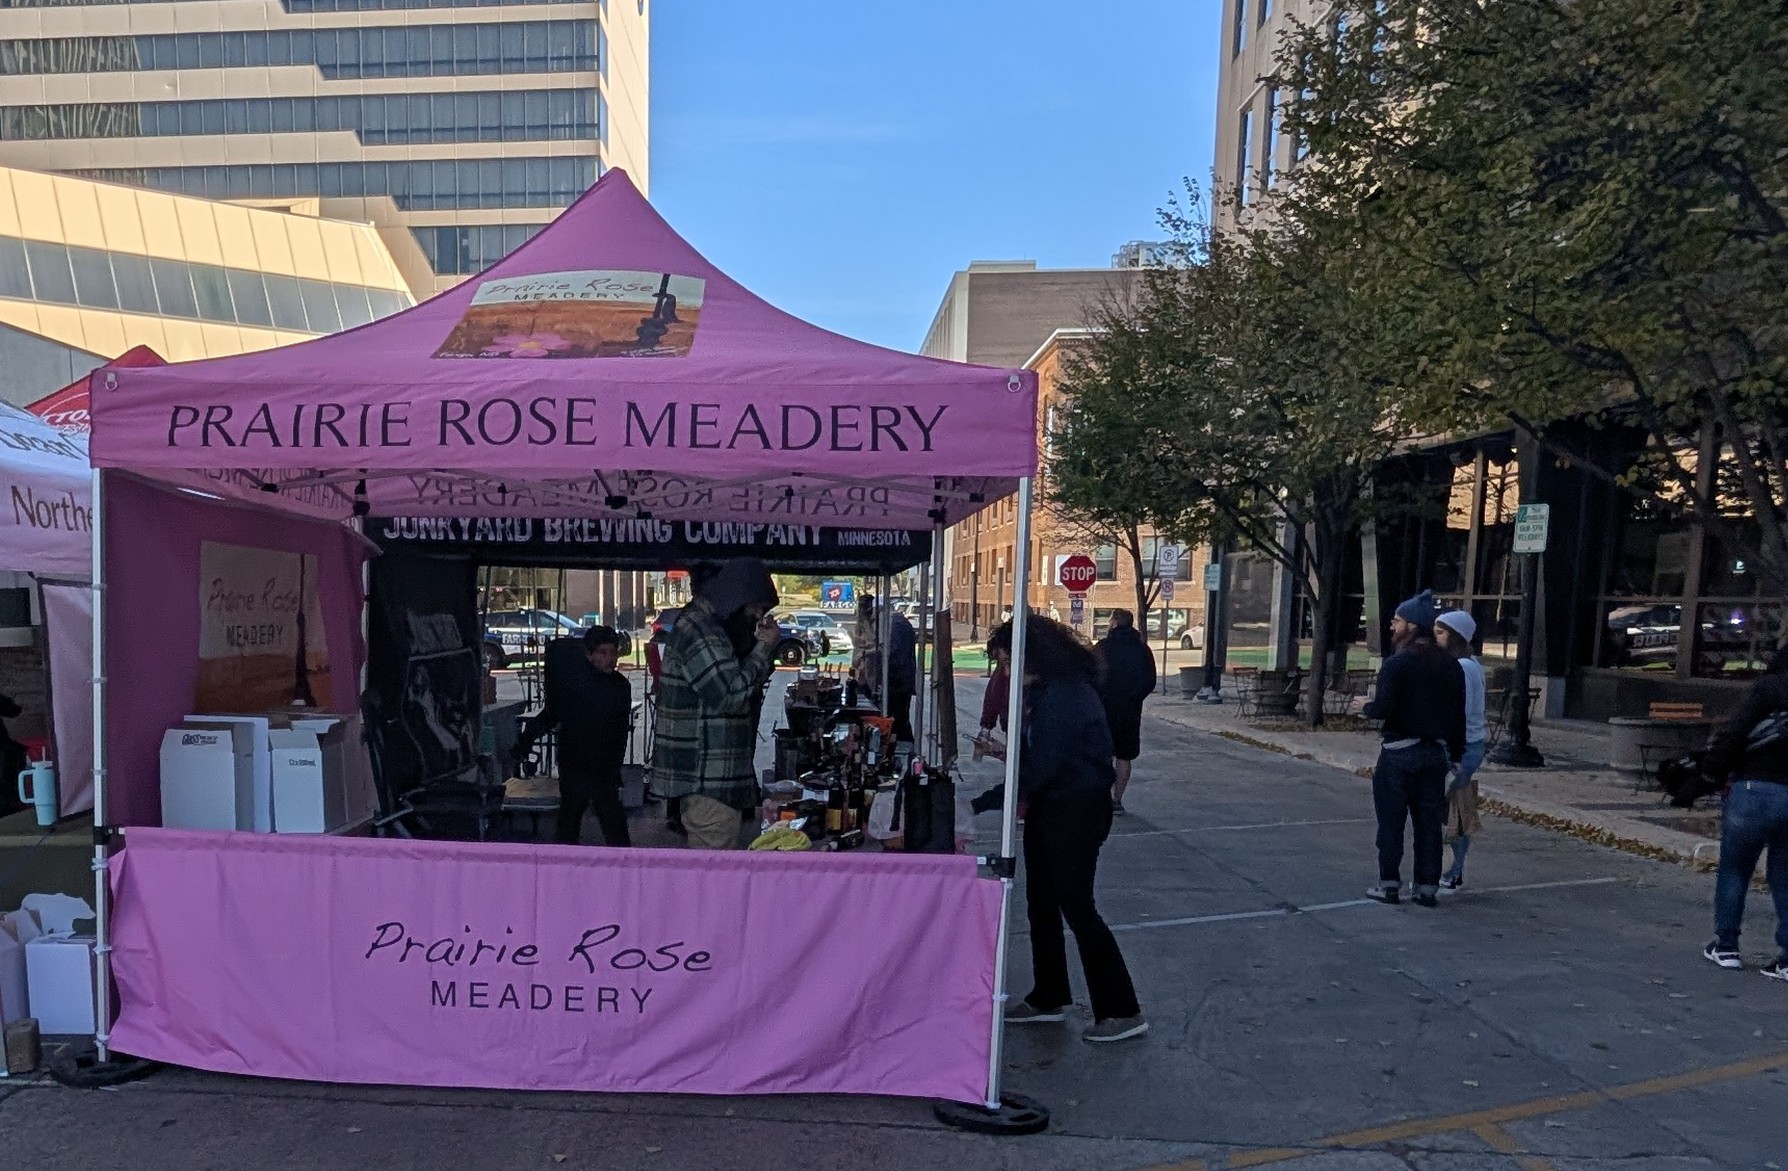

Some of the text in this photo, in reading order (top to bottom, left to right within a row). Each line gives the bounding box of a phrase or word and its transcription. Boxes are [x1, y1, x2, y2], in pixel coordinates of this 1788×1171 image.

[488, 278, 654, 294] Prairie Rose
[514, 292, 625, 301] MEADERY
[167, 396, 949, 452] PRAIRIE ROSE MEADERY
[383, 517, 822, 547] JUNKYARD BREWING COMPANY
[837, 530, 912, 547] MINNESOTA
[1062, 566, 1095, 581] STOP
[365, 921, 713, 974] Prairie Rose
[430, 980, 653, 1014] MEADERY
